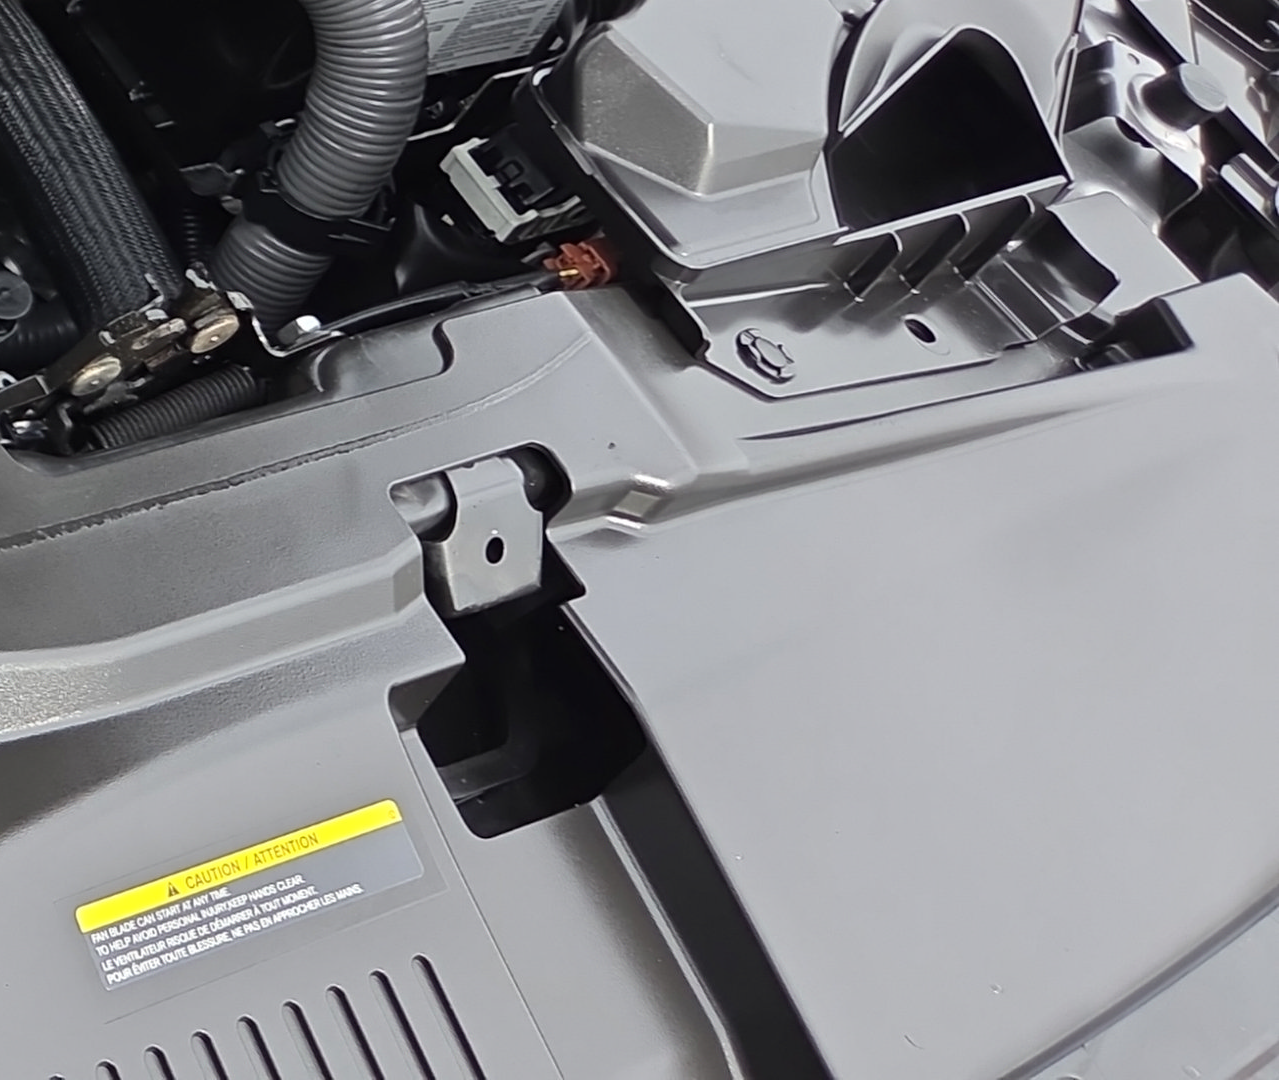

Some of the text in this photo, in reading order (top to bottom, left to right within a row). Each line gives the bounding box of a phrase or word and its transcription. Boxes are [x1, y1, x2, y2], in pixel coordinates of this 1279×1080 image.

[185, 859, 241, 889] CAUTION
[253, 832, 319, 866] ATTENTION
[91, 930, 109, 944] FAN
[108, 920, 137, 938] BLADE
[136, 915, 156, 927] CAN
[155, 904, 181, 921] START
[182, 901, 193, 912] AT
[193, 894, 209, 908] ANY
[95, 945, 110, 957] TO
[108, 936, 132, 952] HELP
[132, 927, 158, 944] AVOID
[157, 912, 202, 935] PERSONAL
[247, 884, 277, 901] HANDS
[101, 960, 115, 972] LE
[113, 940, 167, 966] VENTILATEUR
[165, 928, 198, 948] RISQUE
[197, 924, 211, 936] DE
[209, 908, 254, 932] DÉMARRER
[259, 898, 282, 913] TOUT
[106, 969, 133, 985] POUR
[131, 957, 161, 975] ÉVITER
[160, 947, 189, 965] TOUTE
[230, 926, 245, 939] NE
[243, 920, 262, 934] PAS
[259, 916, 274, 928] EN
[273, 898, 322, 926] APPROCHER
[320, 892, 337, 906] LES
